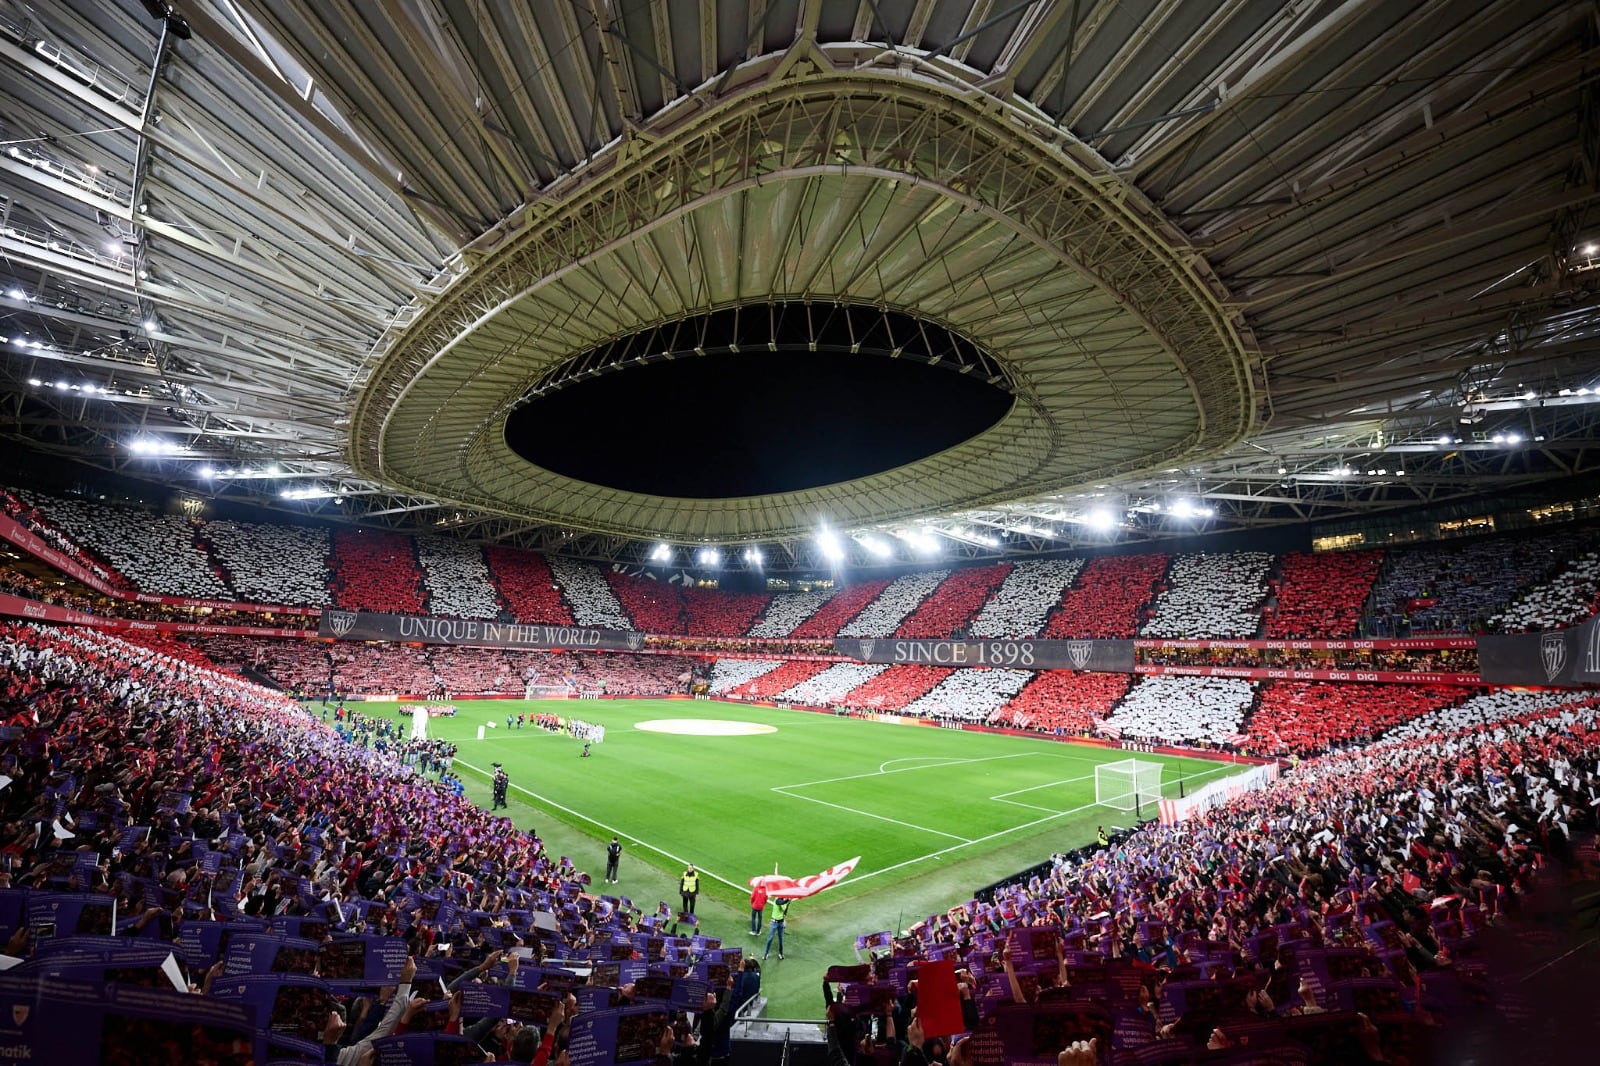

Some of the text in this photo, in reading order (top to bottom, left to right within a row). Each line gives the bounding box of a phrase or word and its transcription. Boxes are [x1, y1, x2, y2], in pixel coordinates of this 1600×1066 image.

[400, 616, 600, 646] UNIQUE IN THE WORLD
[1354, 641, 1374, 649] DIGI
[895, 641, 1034, 666] SINCE 1898
[1294, 671, 1313, 679] DIGI
[1329, 672, 1350, 680] DIGI
[1357, 673, 1378, 681] DIGI
